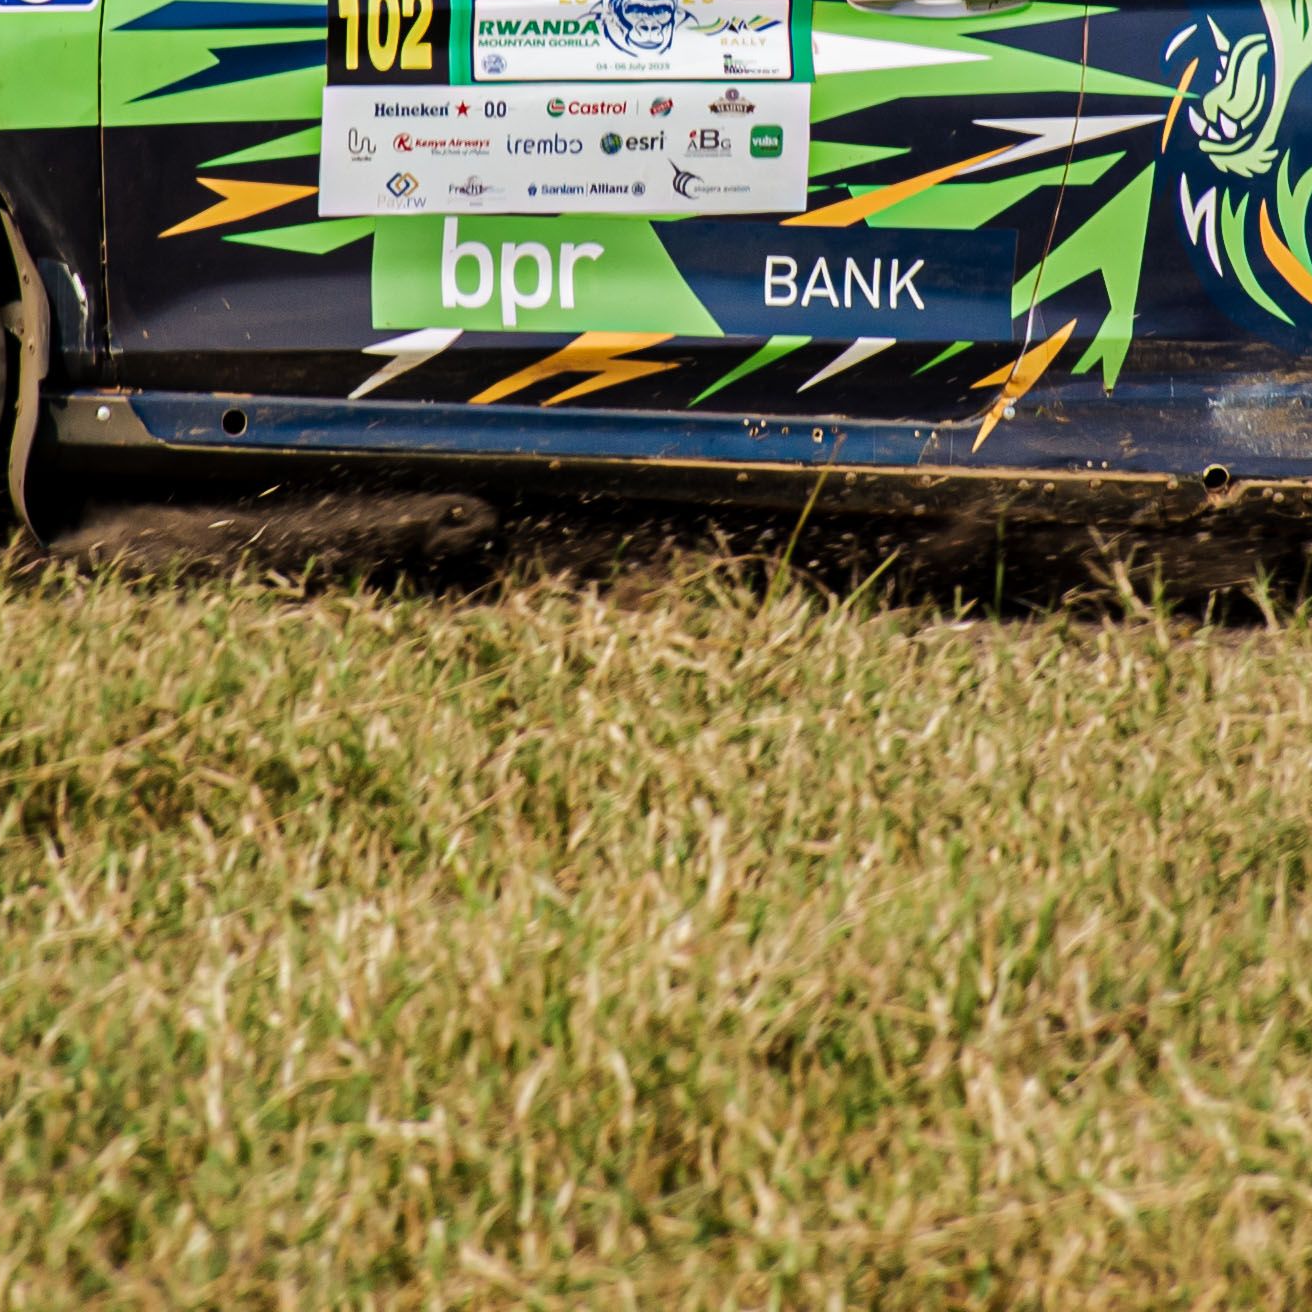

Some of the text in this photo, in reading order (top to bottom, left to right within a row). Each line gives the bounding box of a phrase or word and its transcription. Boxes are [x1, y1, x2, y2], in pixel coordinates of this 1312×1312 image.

[478, 19, 600, 36] RWANDA
[478, 38, 601, 47] MOUNTAIN GORILLA
[374, 101, 450, 118] Heineken
[568, 100, 628, 116] Castrol
[416, 138, 446, 149] Kenya
[625, 130, 665, 151] esri
[589, 183, 629, 195] Allianz
[440, 216, 605, 327] bpr
[763, 254, 927, 310] BANK
